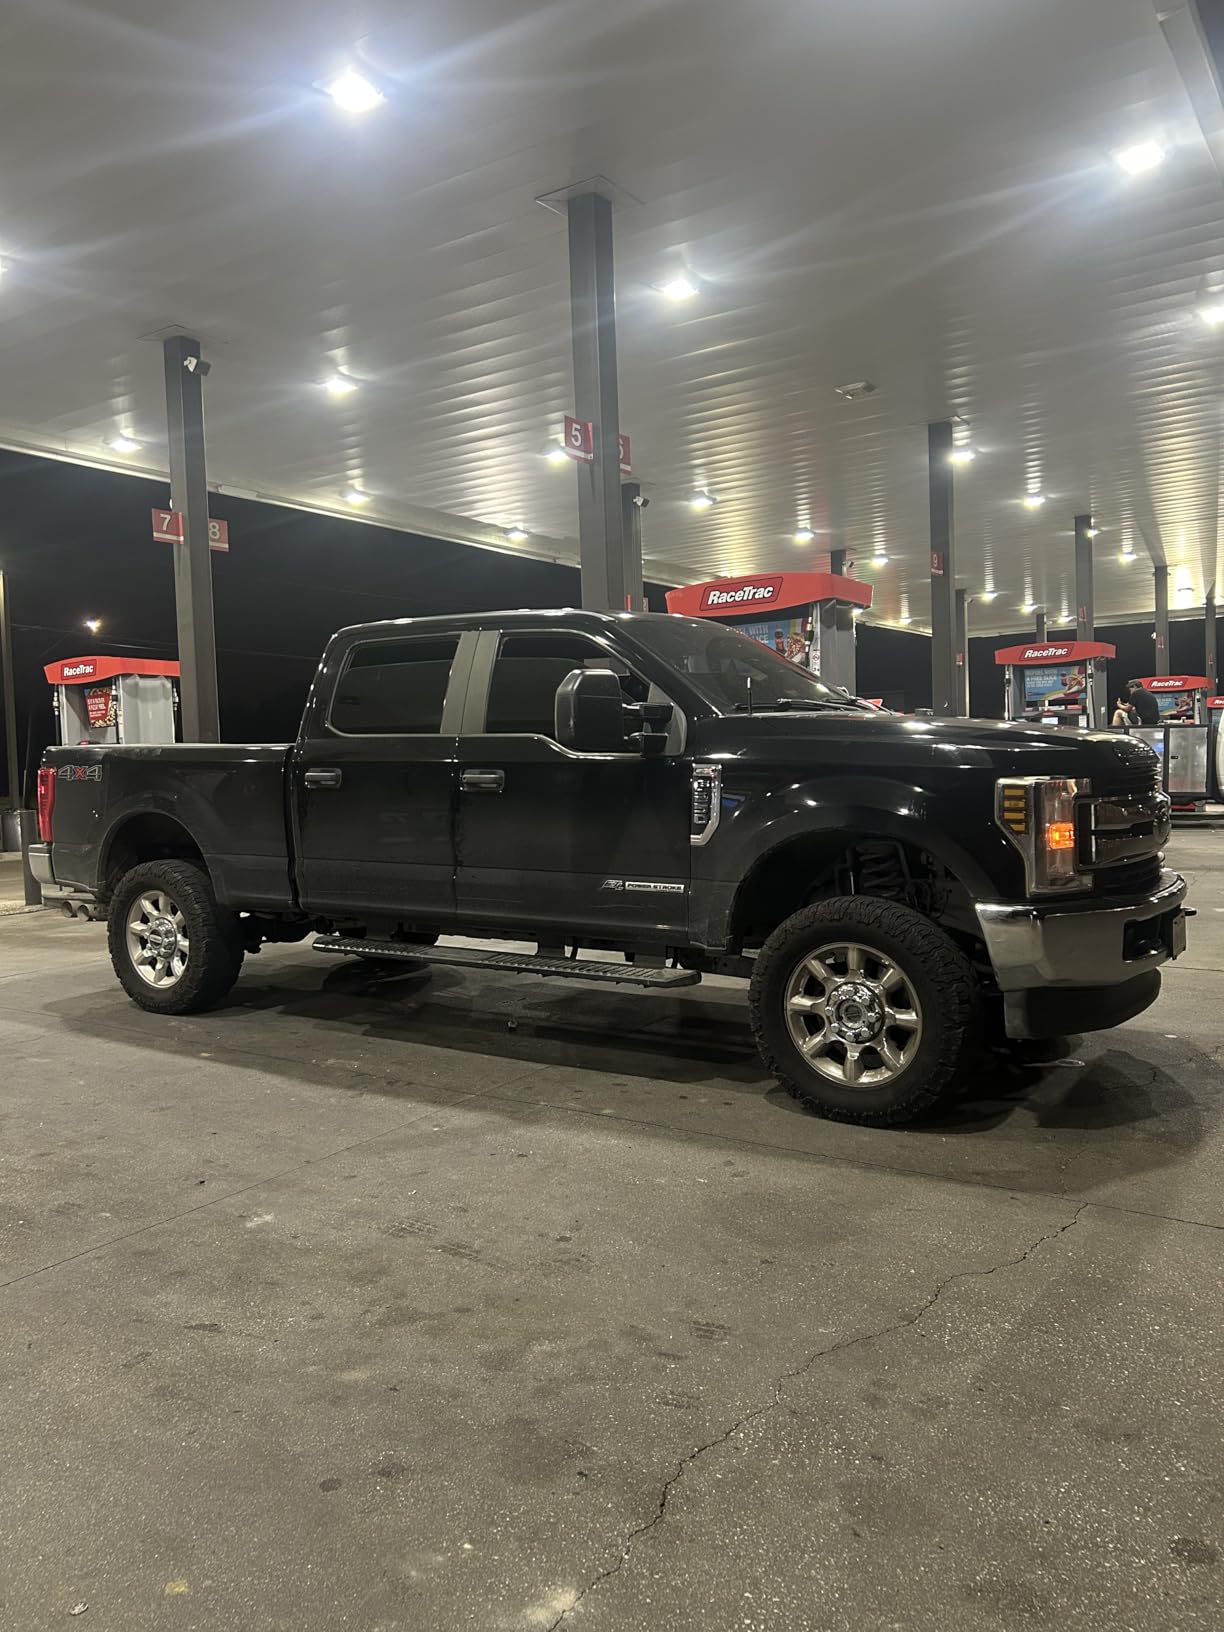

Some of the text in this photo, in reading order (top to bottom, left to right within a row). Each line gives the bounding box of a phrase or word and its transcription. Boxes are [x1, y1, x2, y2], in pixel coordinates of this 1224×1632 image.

[571, 423, 582, 447] 5
[160, 513, 171, 531] 7
[209, 522, 220, 540] 8
[932, 553, 938, 567] 9
[707, 586, 774, 605] RaceTrac
[1024, 647, 1068, 658] RaceTrac
[63, 664, 94, 677] RaceTrac
[1151, 680, 1183, 688] RaceTrac
